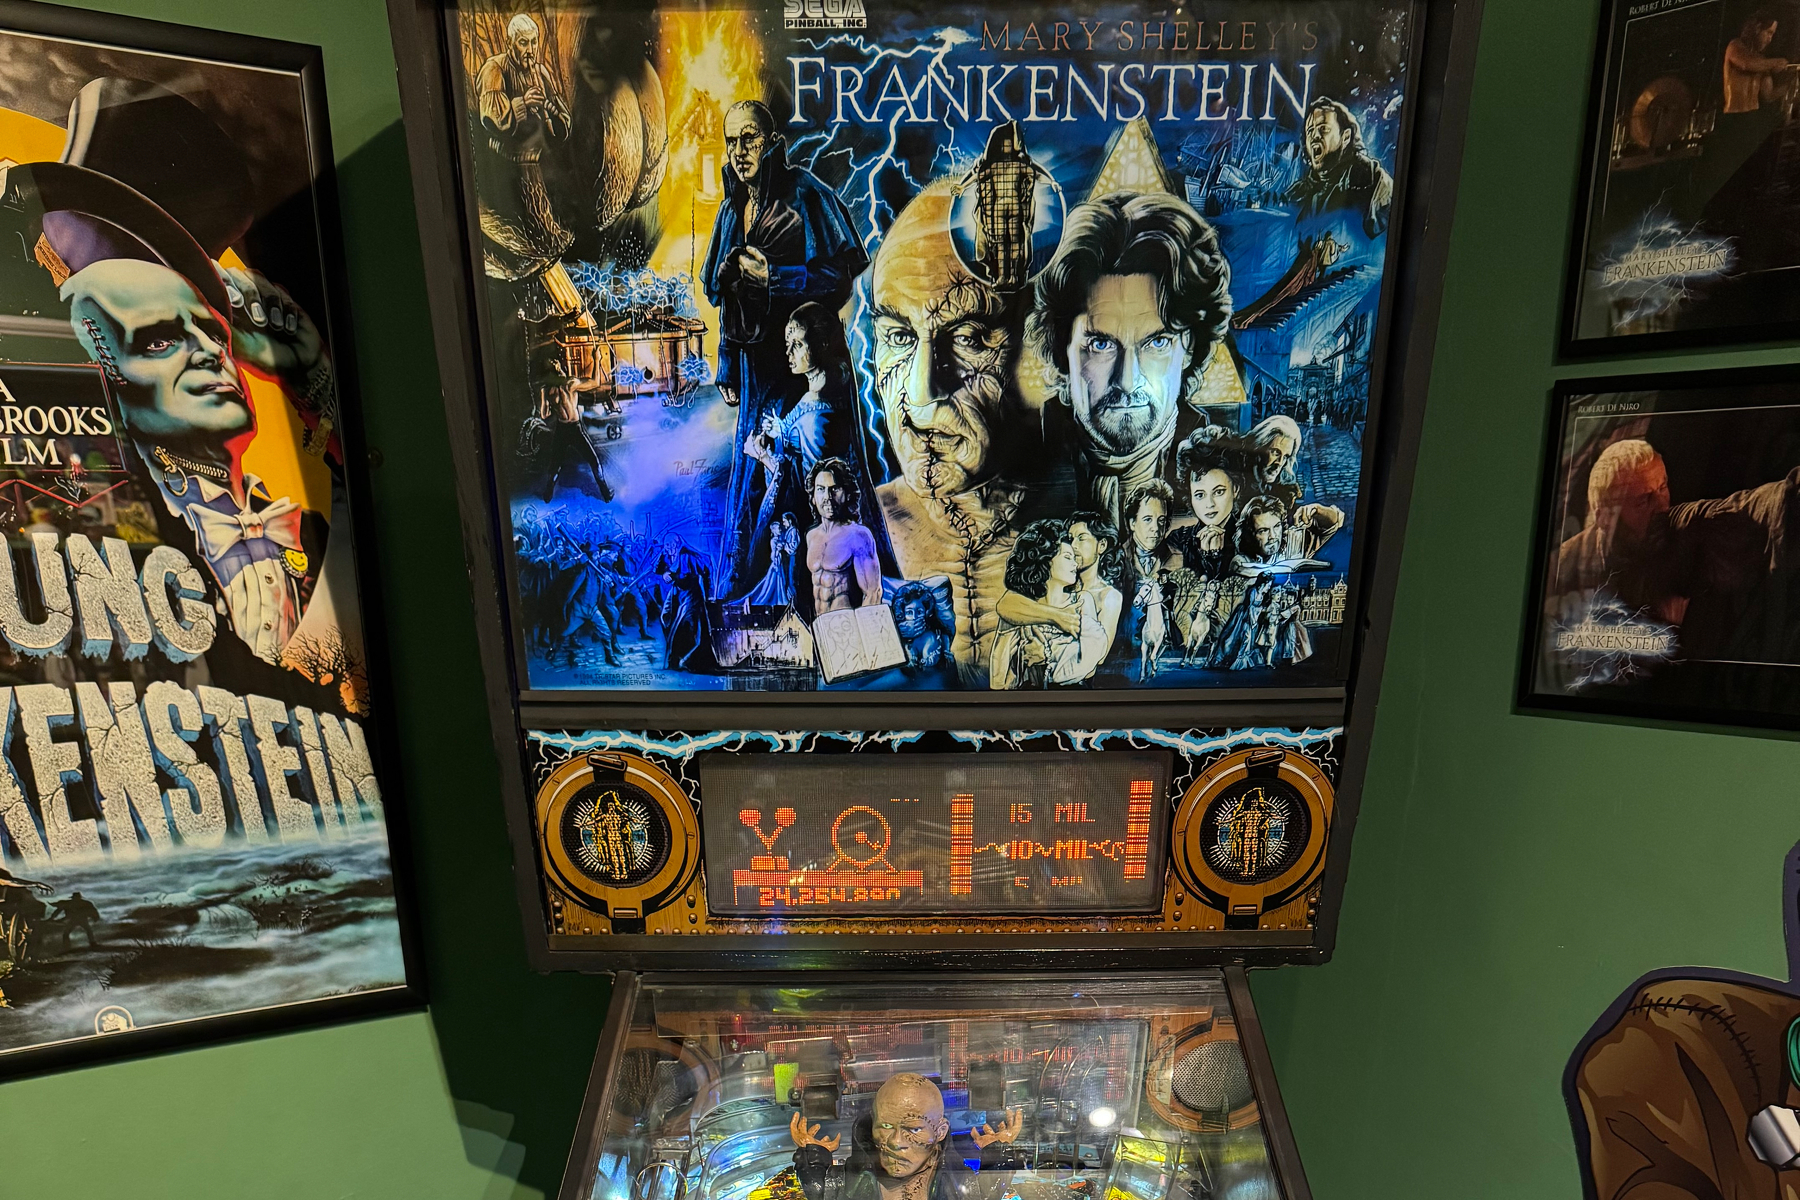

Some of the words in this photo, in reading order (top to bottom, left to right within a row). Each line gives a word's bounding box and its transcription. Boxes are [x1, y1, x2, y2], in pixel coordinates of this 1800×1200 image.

[783, 0, 867, 18] SEGA
[785, 19, 840, 28] PINBALL,
[843, 19, 867, 27] INC.
[980, 22, 1103, 51] MARY
[1118, 22, 1319, 51] SHELLEY'S
[788, 56, 1317, 123] FRANKENSTEIN
[1604, 249, 1728, 282] FRANKENSTEIN
[1625, 253, 1653, 262] MARY
[1578, 404, 1605, 413] ROBERT
[1619, 402, 1640, 411] NIRO
[1577, 625, 1602, 633] MARY
[1557, 633, 1671, 651] FRANKENSTEIN
[1009, 803, 1033, 824] 15
[1055, 803, 1096, 824] MIL
[1055, 840, 1094, 860] MIL
